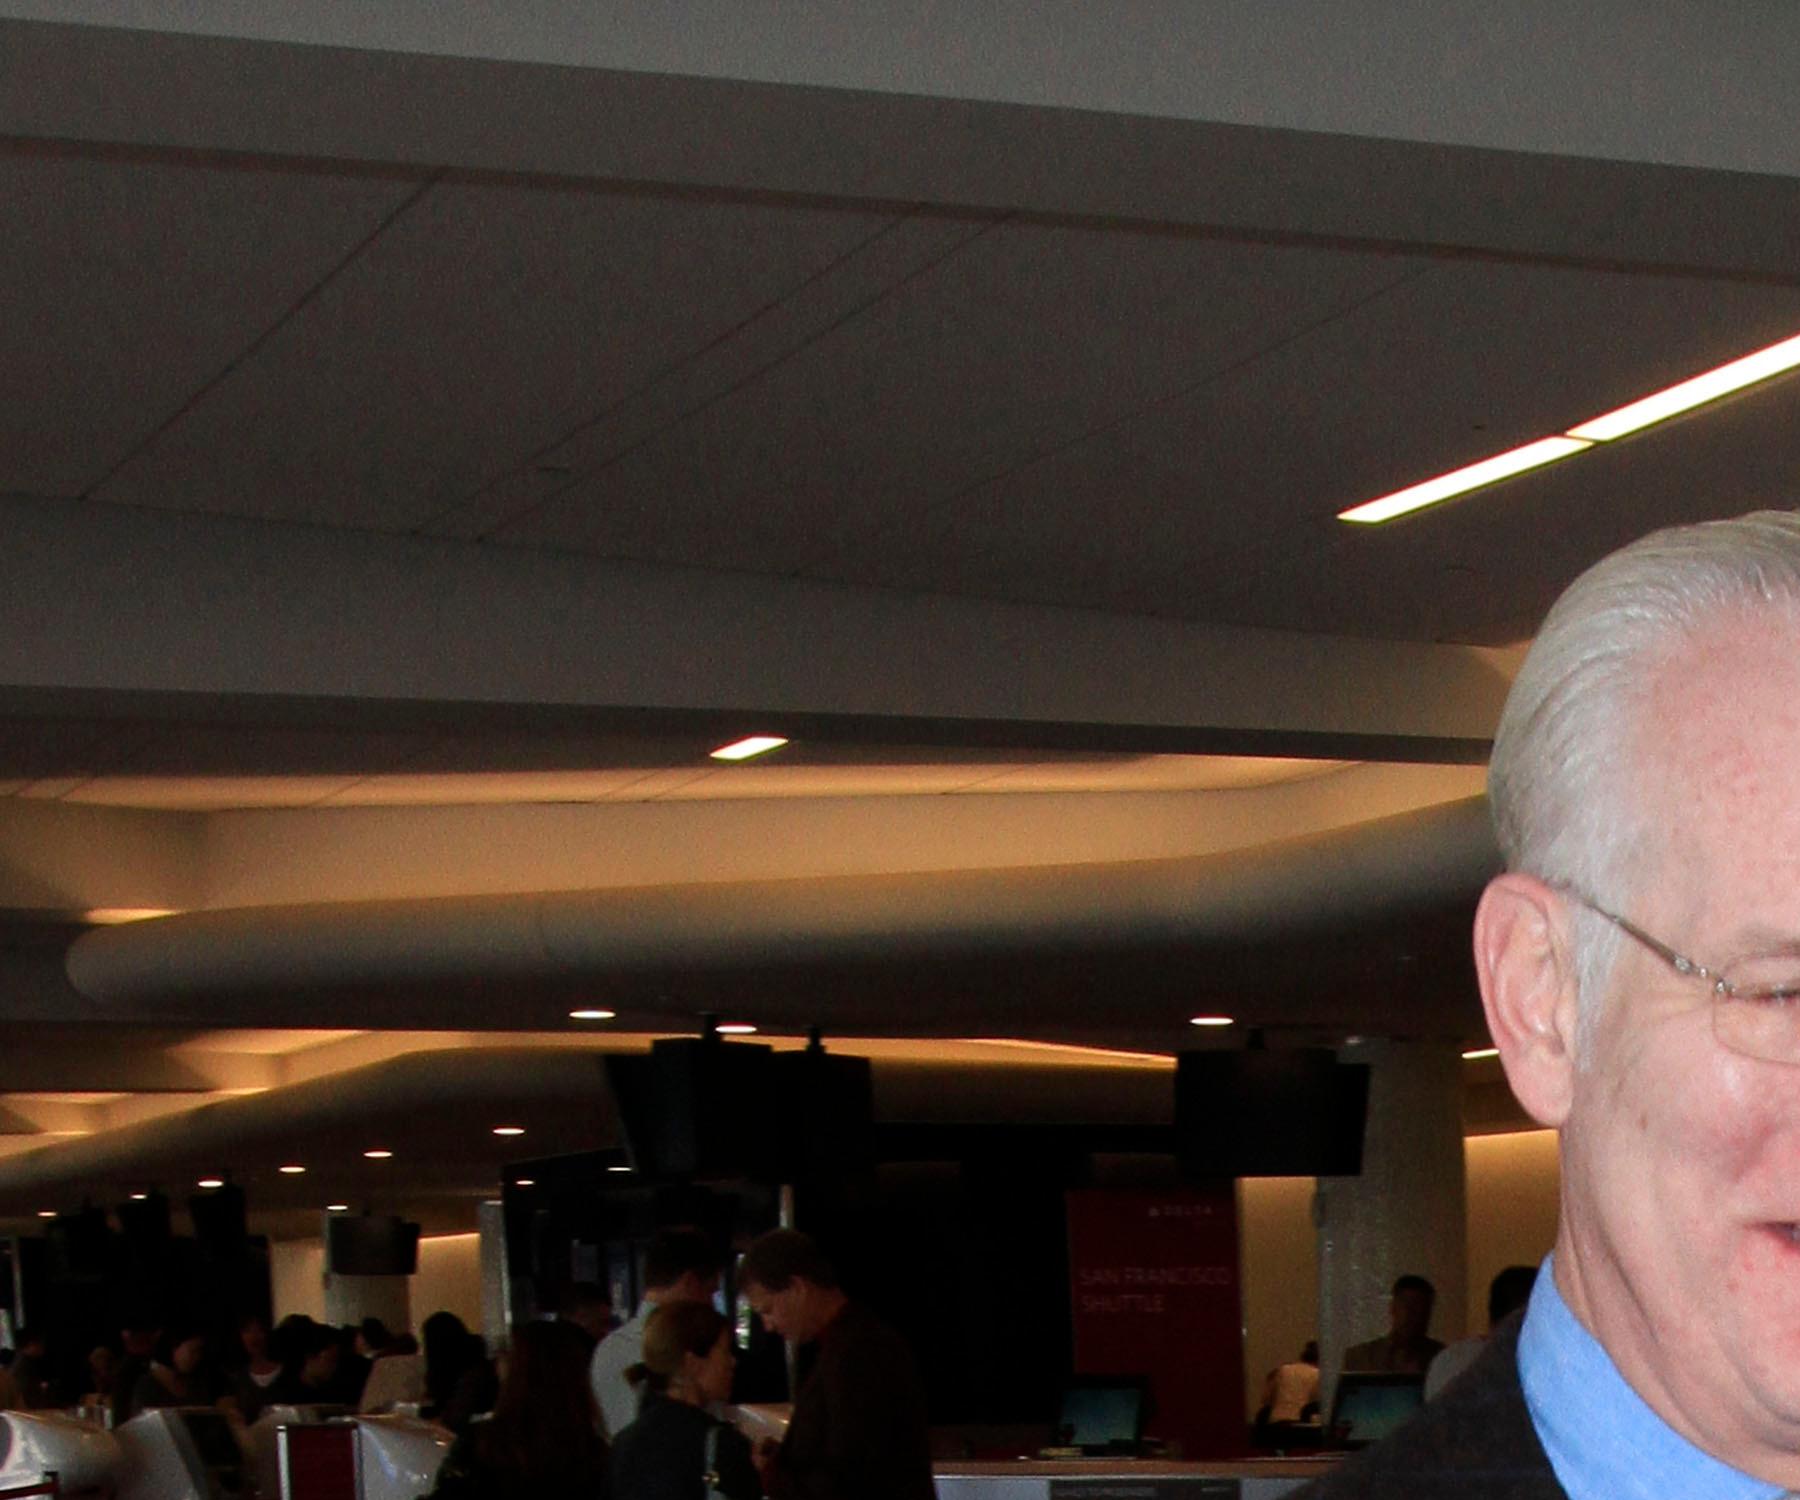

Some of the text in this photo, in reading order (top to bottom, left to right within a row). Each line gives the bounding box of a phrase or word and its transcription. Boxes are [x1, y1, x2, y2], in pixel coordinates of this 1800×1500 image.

[1080, 1266, 1232, 1286] SAN FRANCISCO
[1080, 1293, 1167, 1313] SHUTTLE
